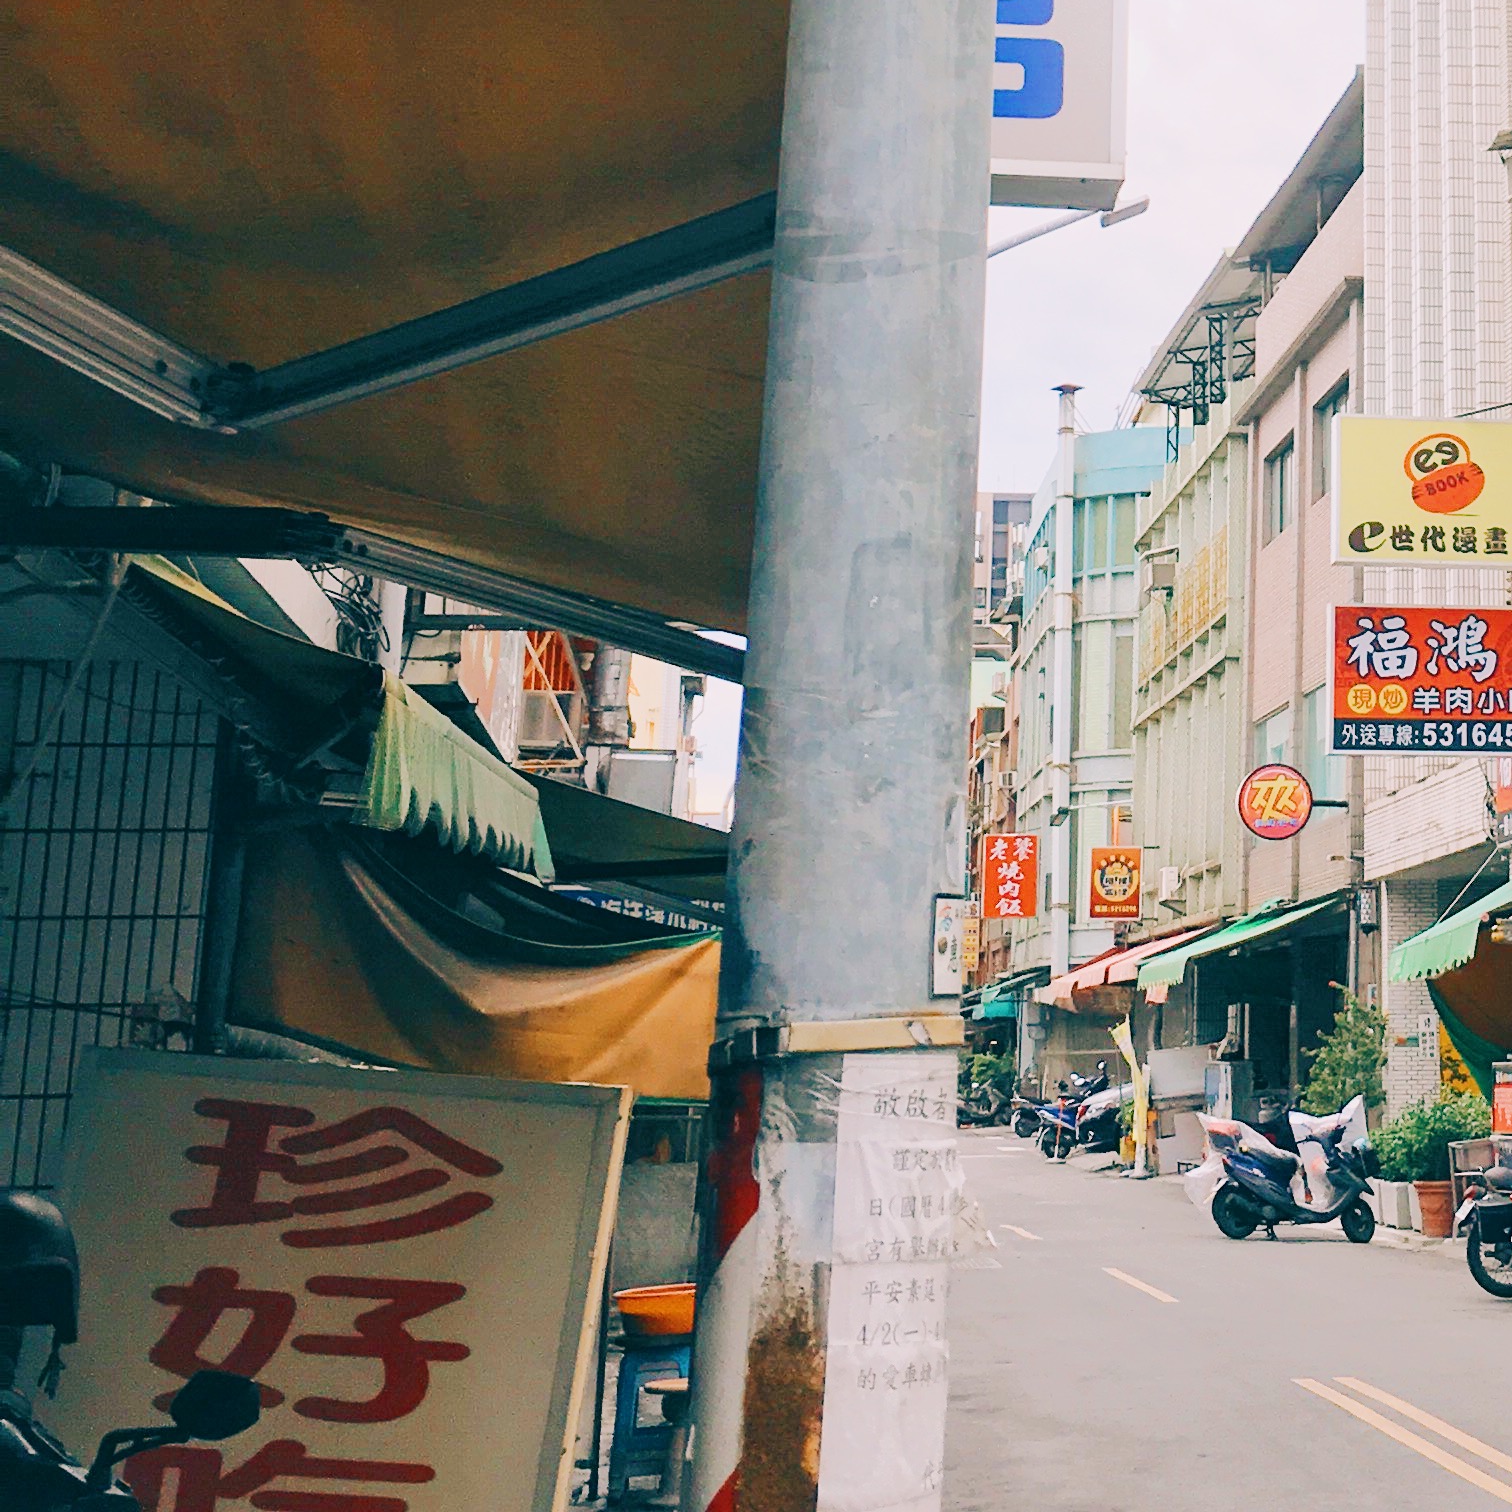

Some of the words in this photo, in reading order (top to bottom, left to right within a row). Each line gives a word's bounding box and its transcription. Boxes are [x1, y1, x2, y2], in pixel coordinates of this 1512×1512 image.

[1424, 470, 1470, 497] BOOK
[1346, 614, 1498, 683] 福鴻
[873, 1087, 948, 1121] 敬啟者
